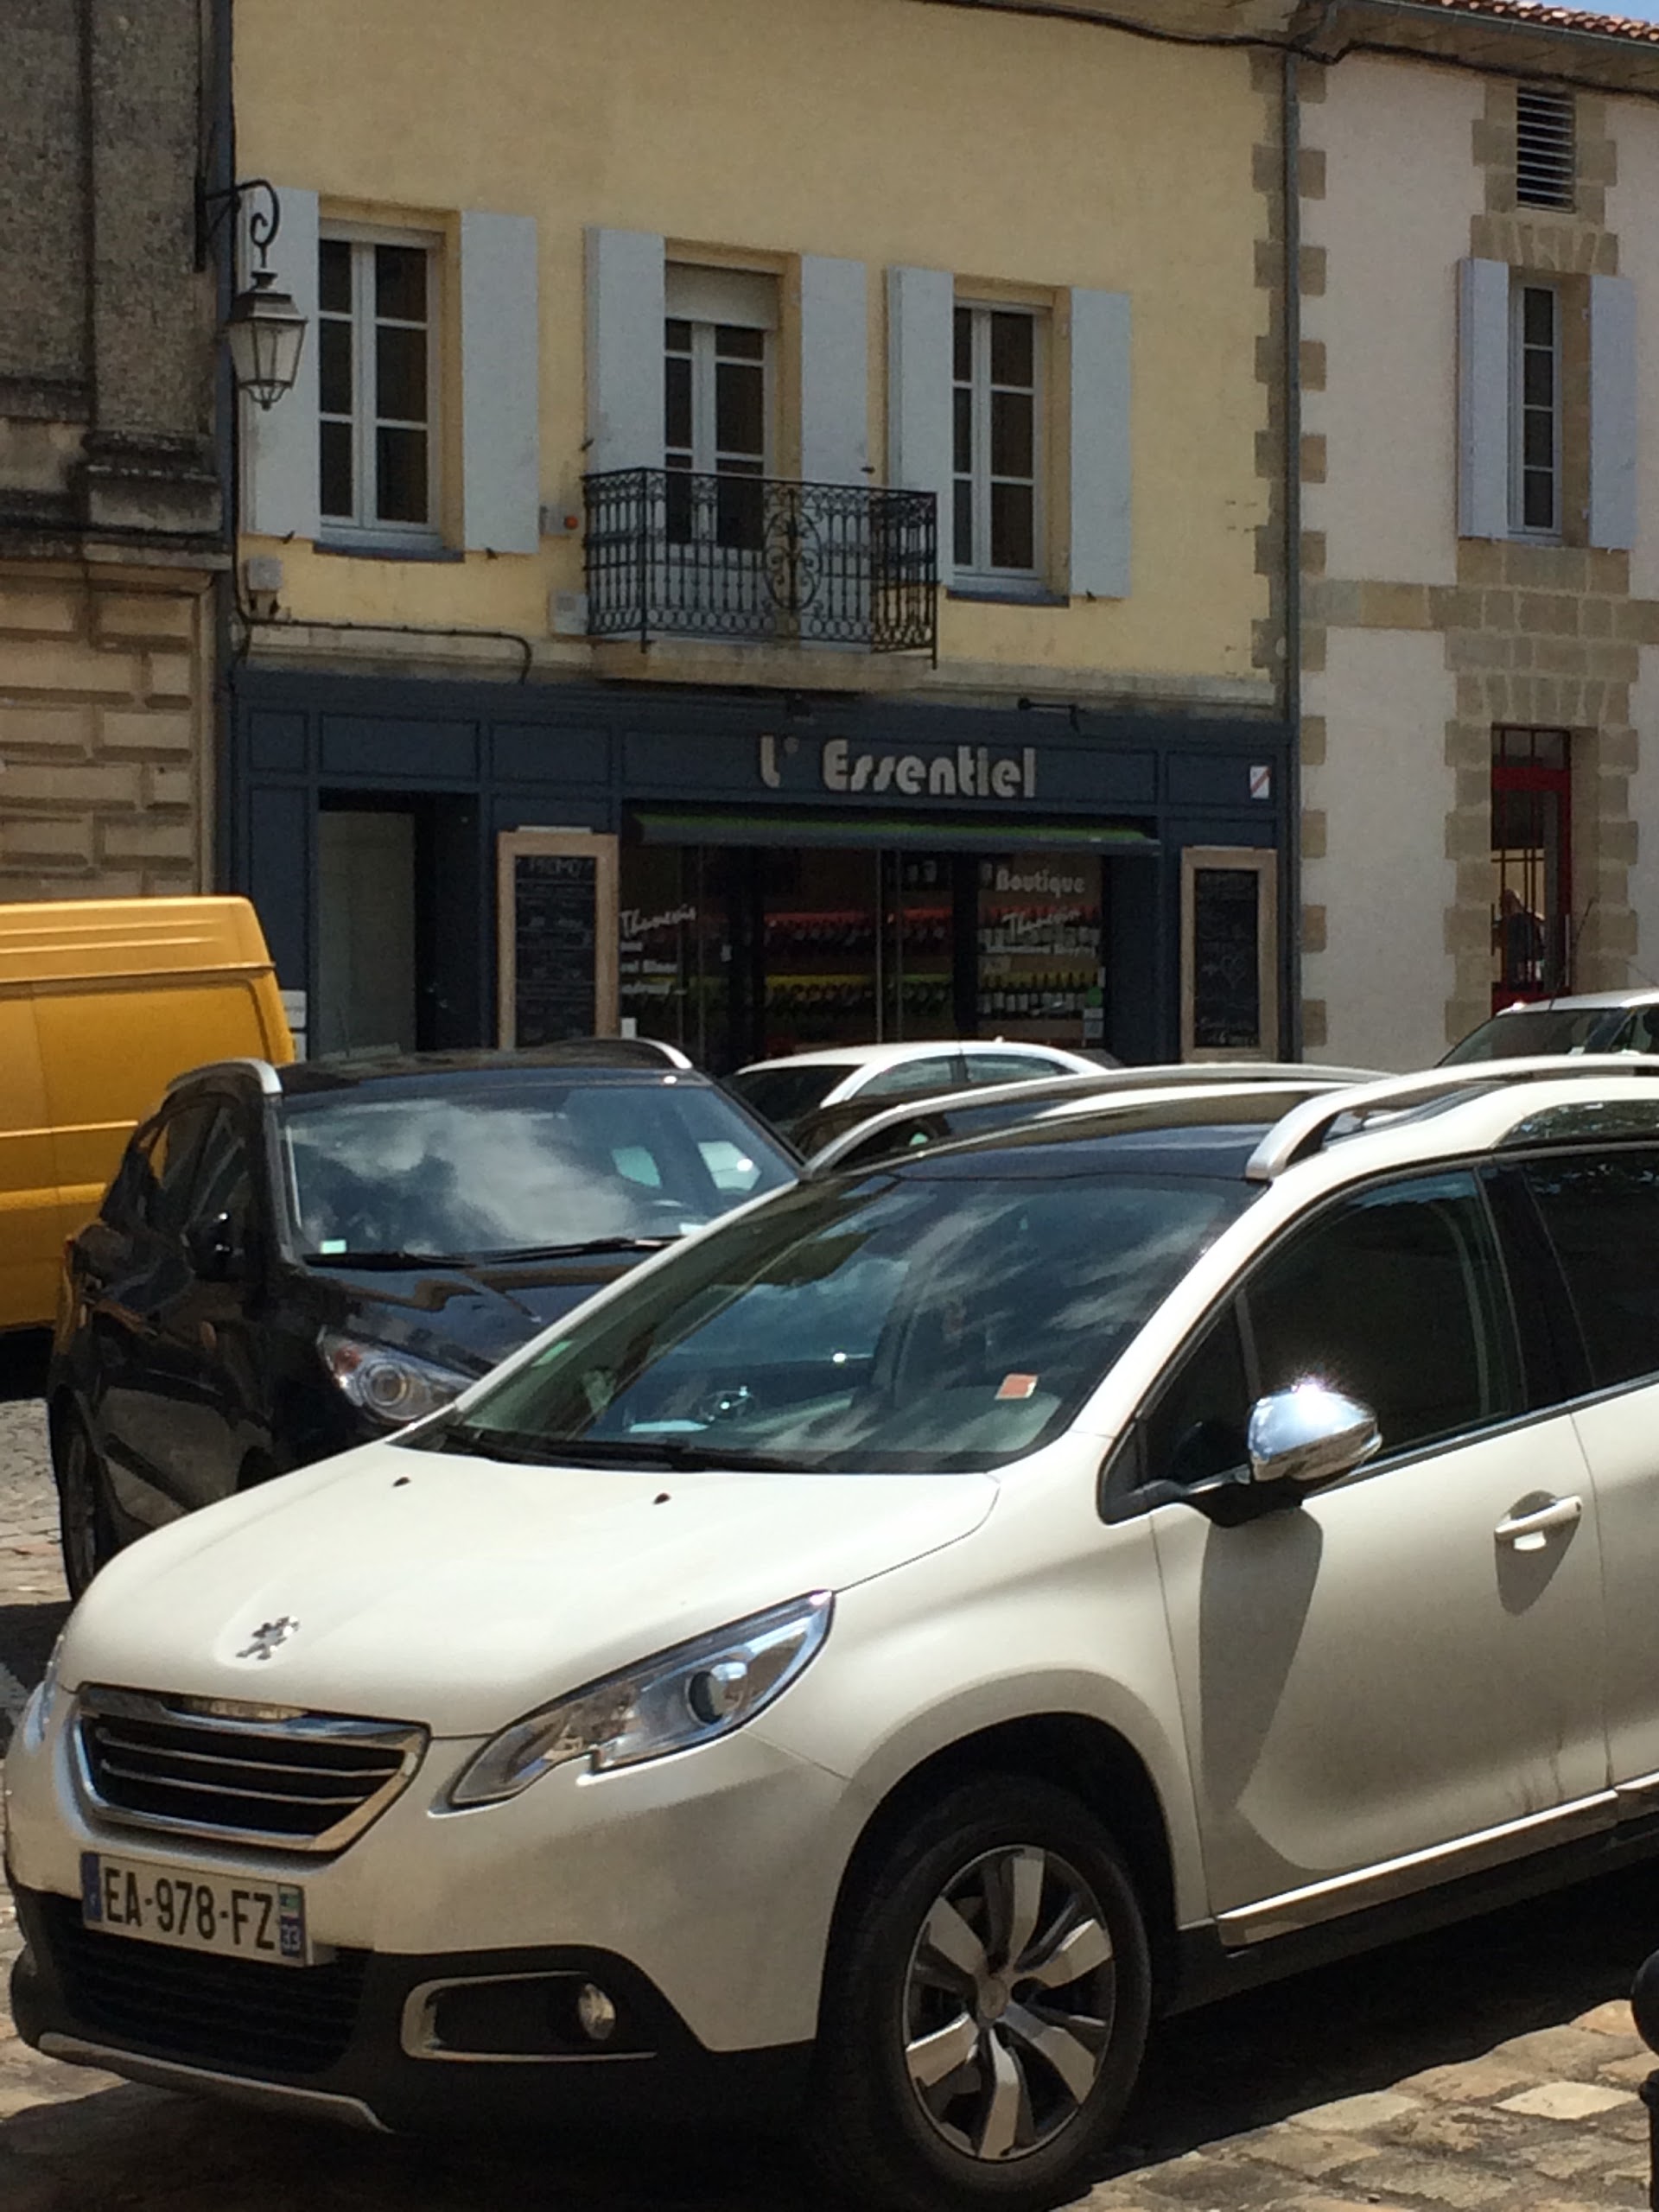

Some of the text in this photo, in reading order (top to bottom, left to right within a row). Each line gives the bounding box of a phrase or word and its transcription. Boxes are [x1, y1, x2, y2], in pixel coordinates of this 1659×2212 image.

[823, 739, 1036, 798] Essentiel
[995, 868, 1086, 899] Boutique
[104, 1866, 276, 1950] EA-978-FZ
[280, 1923, 301, 1951] 33
